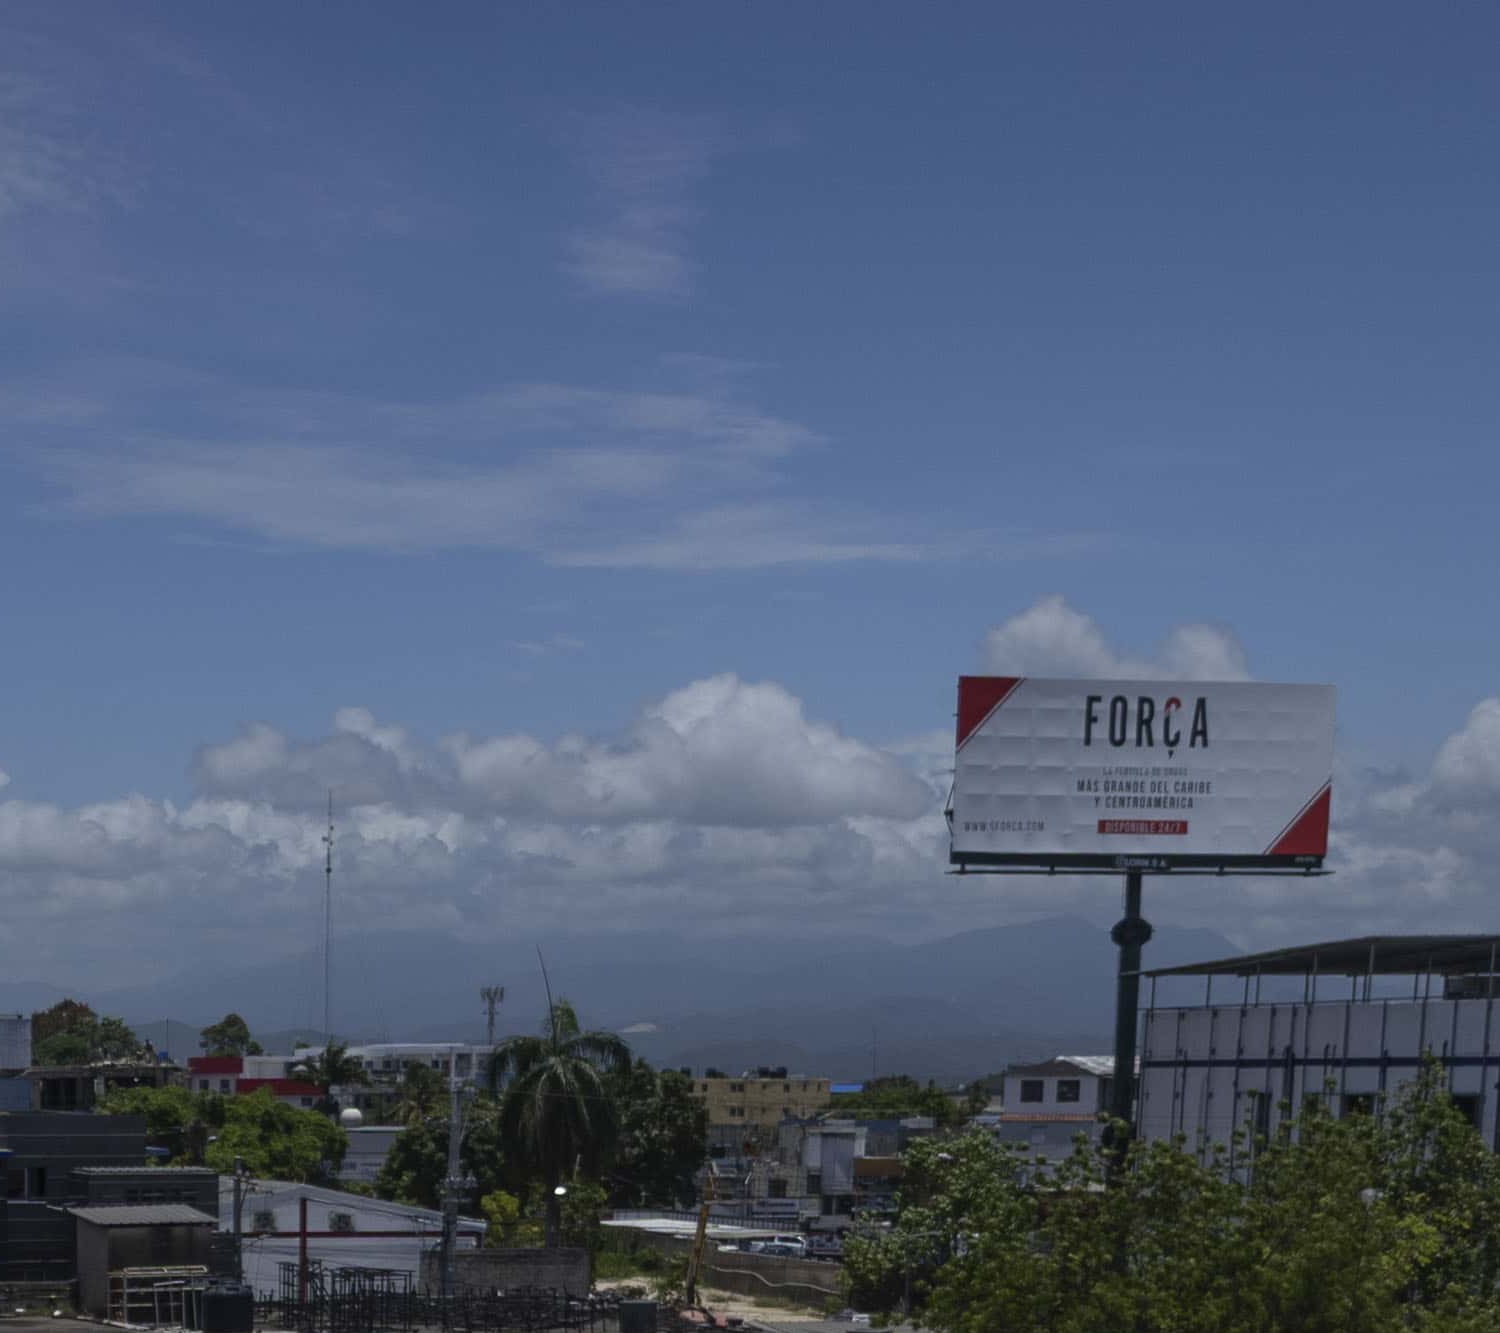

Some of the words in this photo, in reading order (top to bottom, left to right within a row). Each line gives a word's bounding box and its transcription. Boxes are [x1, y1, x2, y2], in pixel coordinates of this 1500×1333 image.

[1083, 695, 1210, 758] FORÇA
[1103, 780, 1146, 793] GRANDE
[1150, 781, 1169, 794] DEL
[1173, 782, 1212, 795] CARIBE
[1095, 797, 1101, 808] Y
